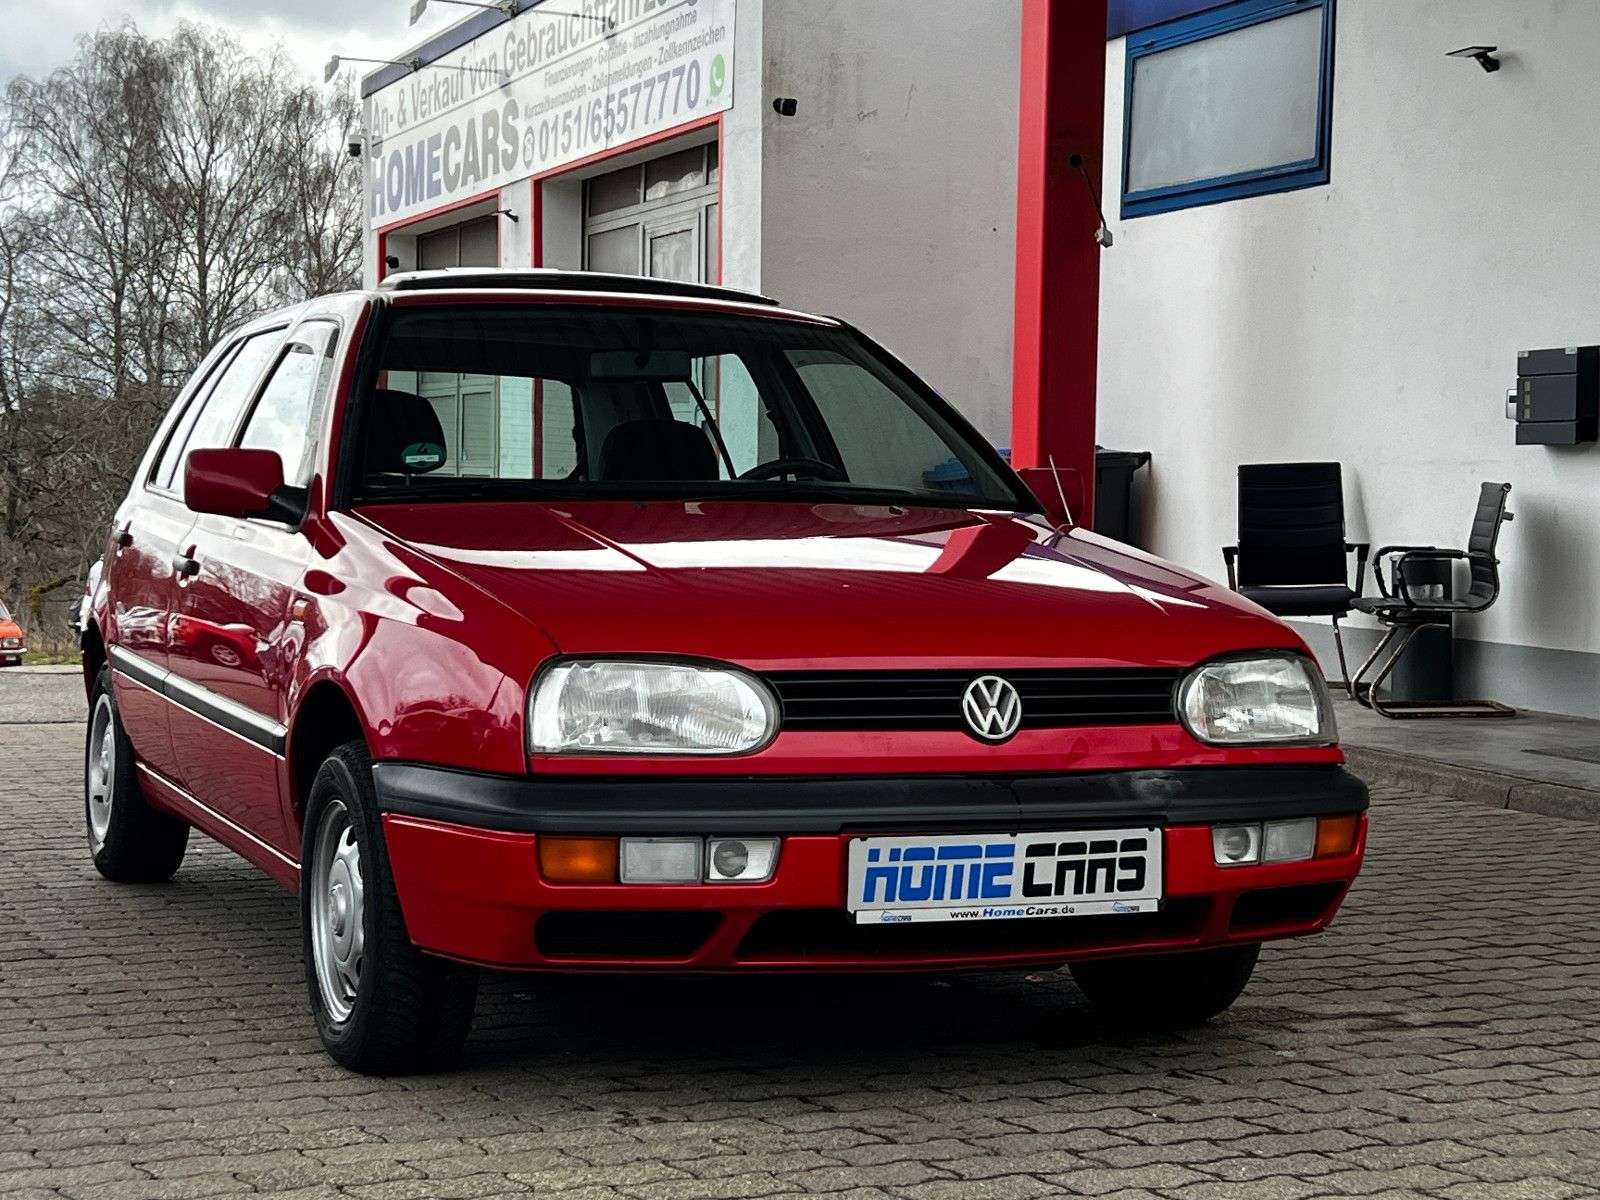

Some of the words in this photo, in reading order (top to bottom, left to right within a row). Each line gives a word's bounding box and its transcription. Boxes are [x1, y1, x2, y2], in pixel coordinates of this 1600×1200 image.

[658, 24, 726, 66] Zollkennzeichen
[398, 88, 407, 129] &
[411, 58, 467, 122] Verkauf
[469, 54, 498, 95] von
[540, 59, 701, 162] 0151/65577770
[370, 98, 519, 218] HOMECARS
[963, 675, 1021, 739] VW
[862, 843, 1016, 902] HOME
[949, 904, 1075, 919] www.HomeCars.de
